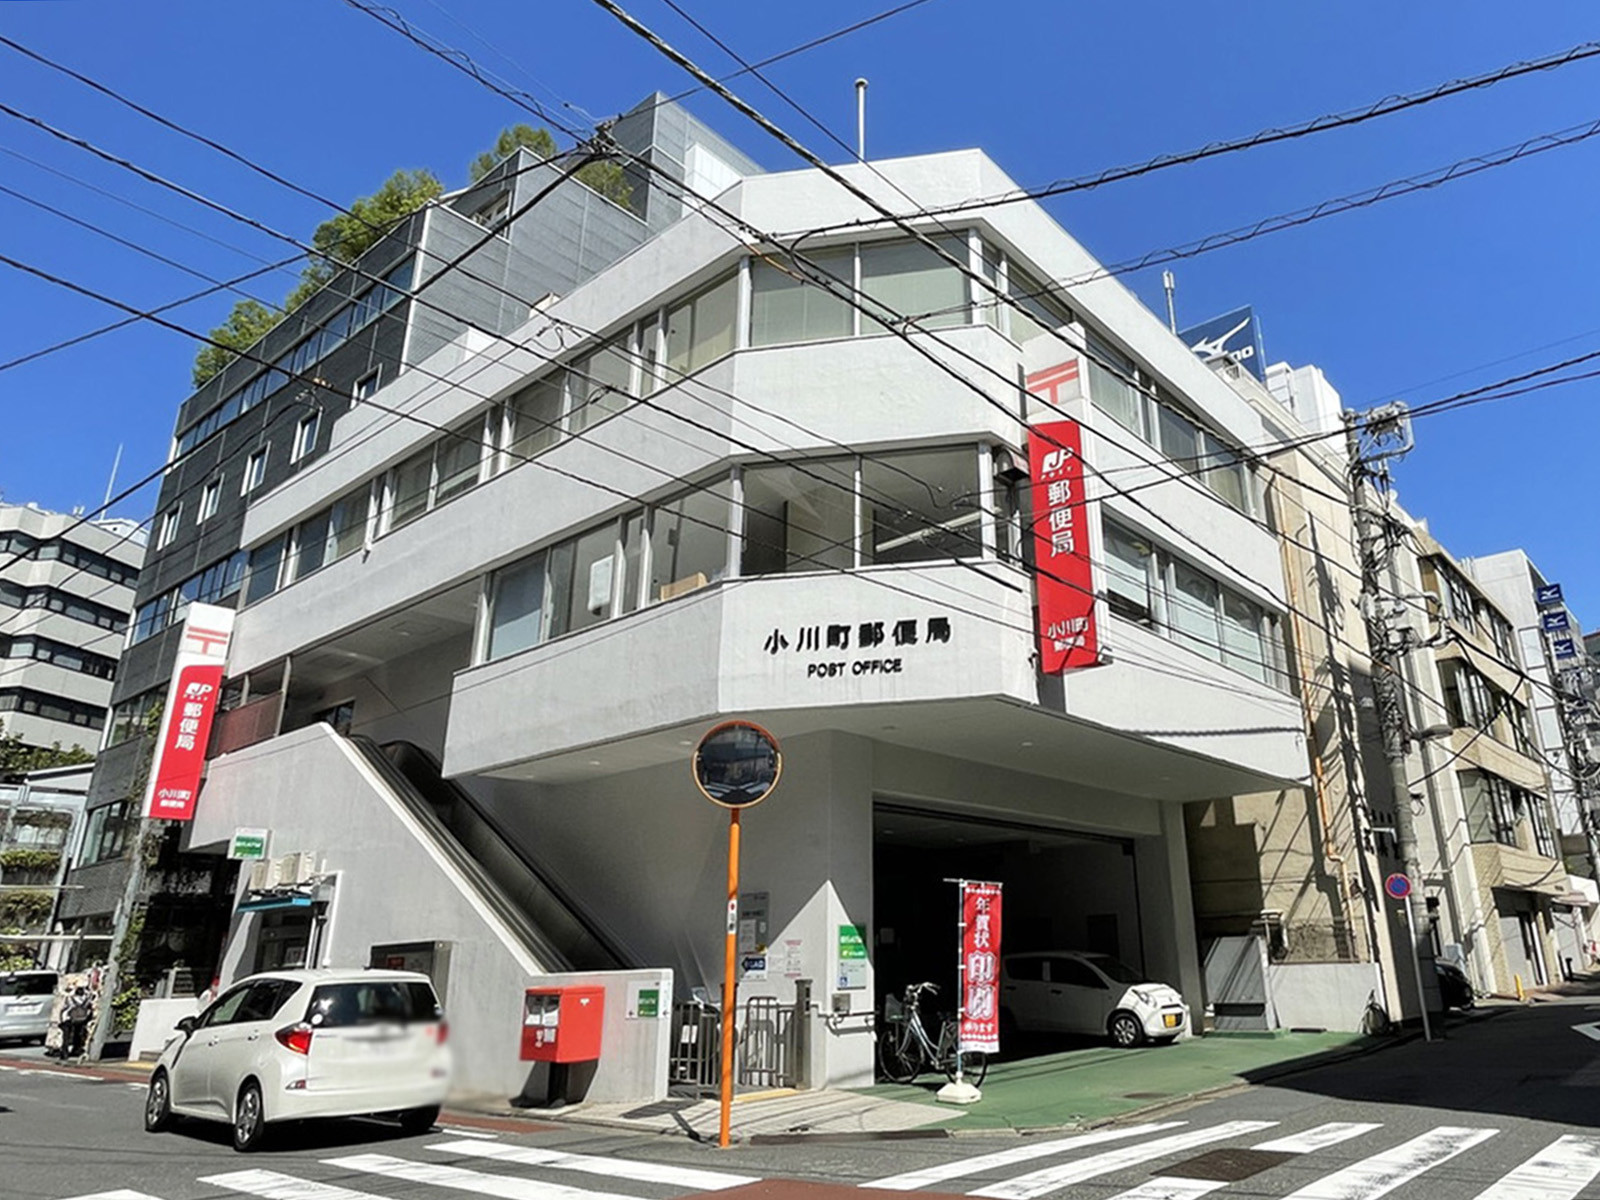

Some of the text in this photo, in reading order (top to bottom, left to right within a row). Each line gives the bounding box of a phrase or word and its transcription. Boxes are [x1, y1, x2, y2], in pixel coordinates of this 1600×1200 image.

[1048, 479, 1075, 558] 郵便局
[763, 617, 951, 655] 小川町郵便局
[807, 658, 903, 678] POST OFFICE
[174, 702, 204, 751] 郵便局
[973, 897, 991, 949] 年賀状
